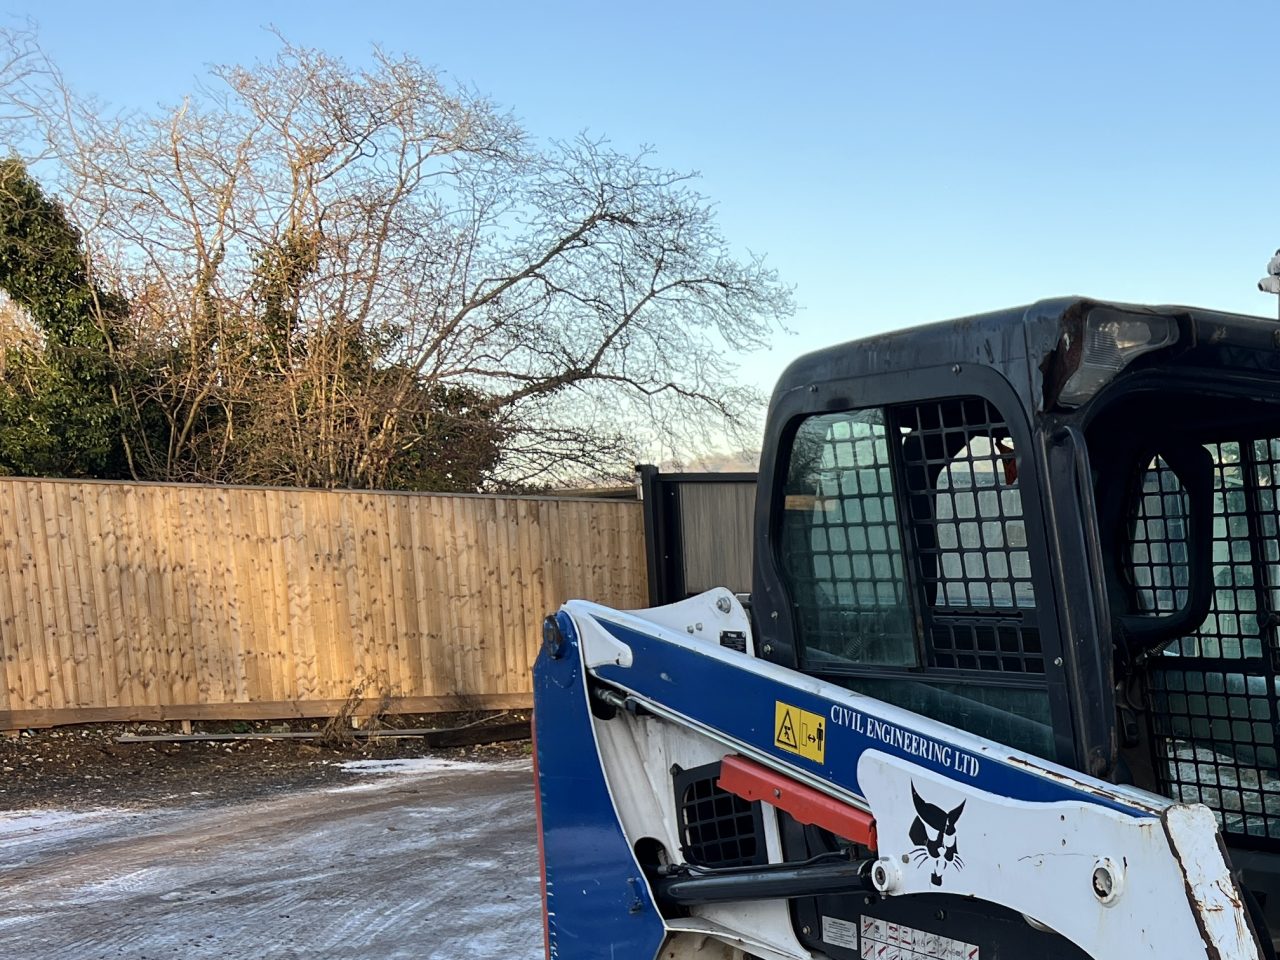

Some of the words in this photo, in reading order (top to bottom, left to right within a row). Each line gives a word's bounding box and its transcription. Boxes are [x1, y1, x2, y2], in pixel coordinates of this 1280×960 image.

[830, 704, 864, 734] CIVIL
[866, 717, 952, 767] ENGINEERING
[954, 750, 980, 777] LTD
